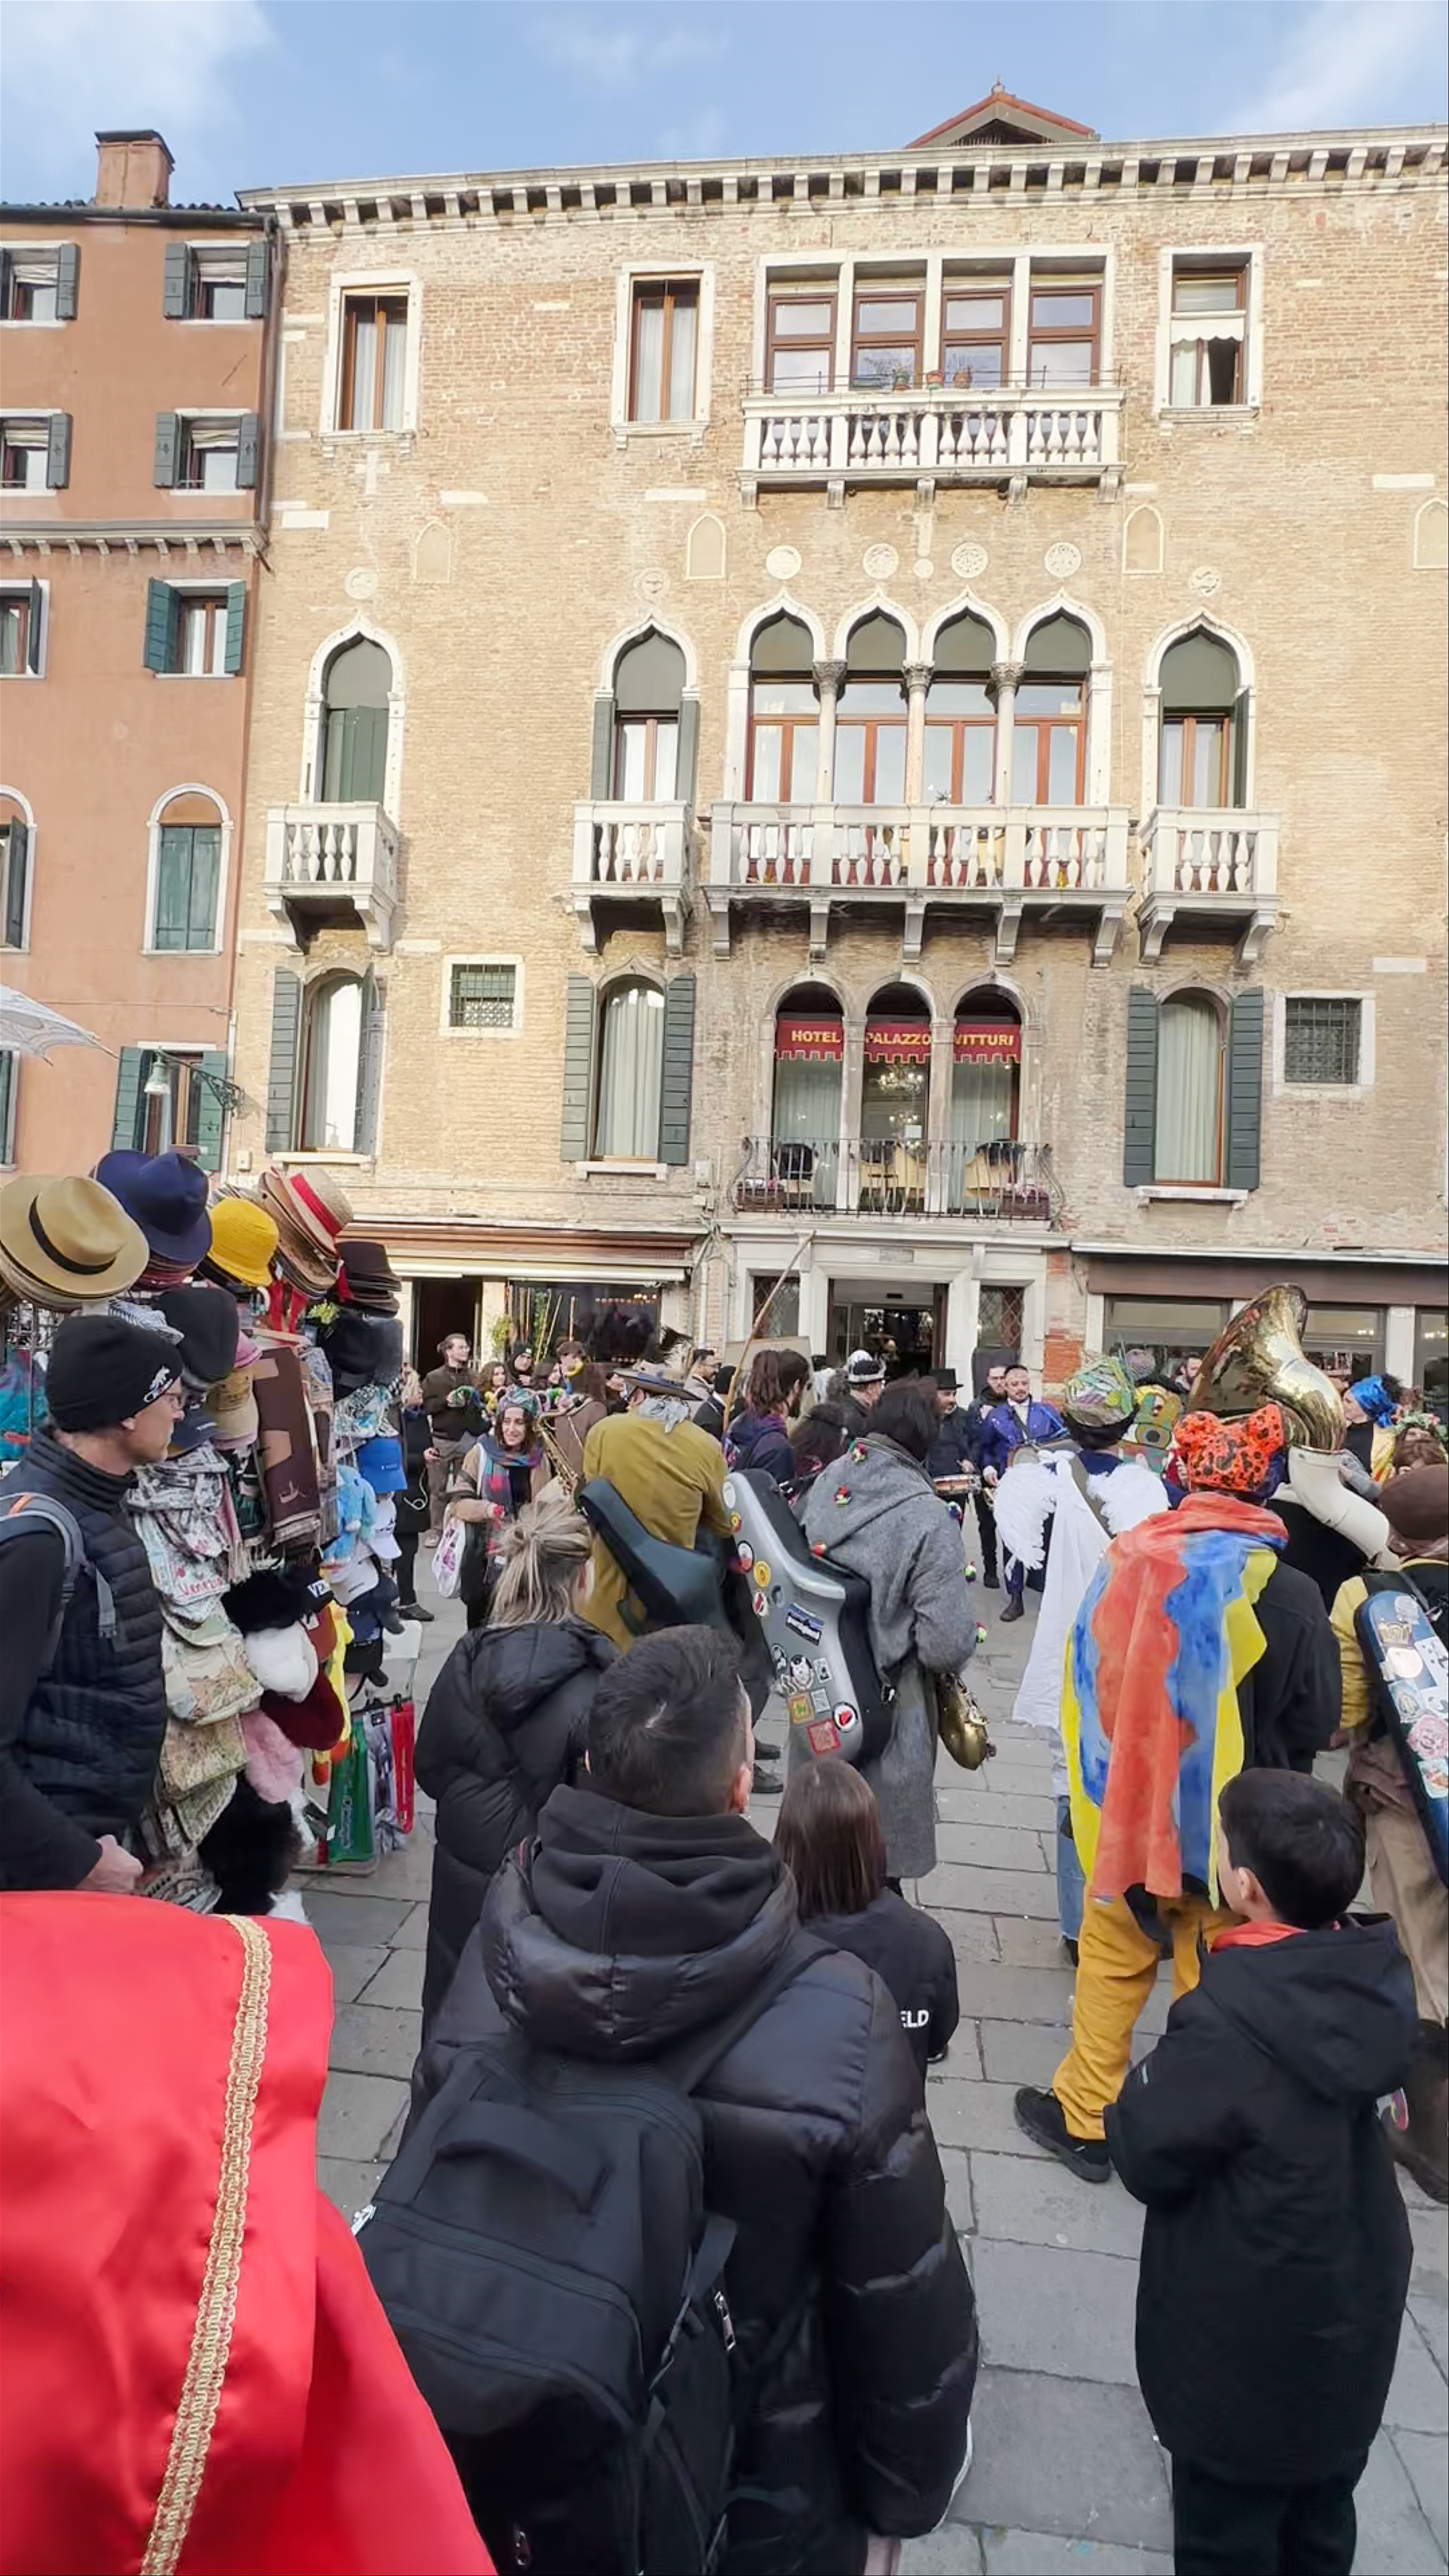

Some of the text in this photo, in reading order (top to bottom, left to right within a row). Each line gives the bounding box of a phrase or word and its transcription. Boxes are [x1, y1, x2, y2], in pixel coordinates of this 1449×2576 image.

[792, 1030, 1014, 1046] HOTEL PALAZZO VITTURI
